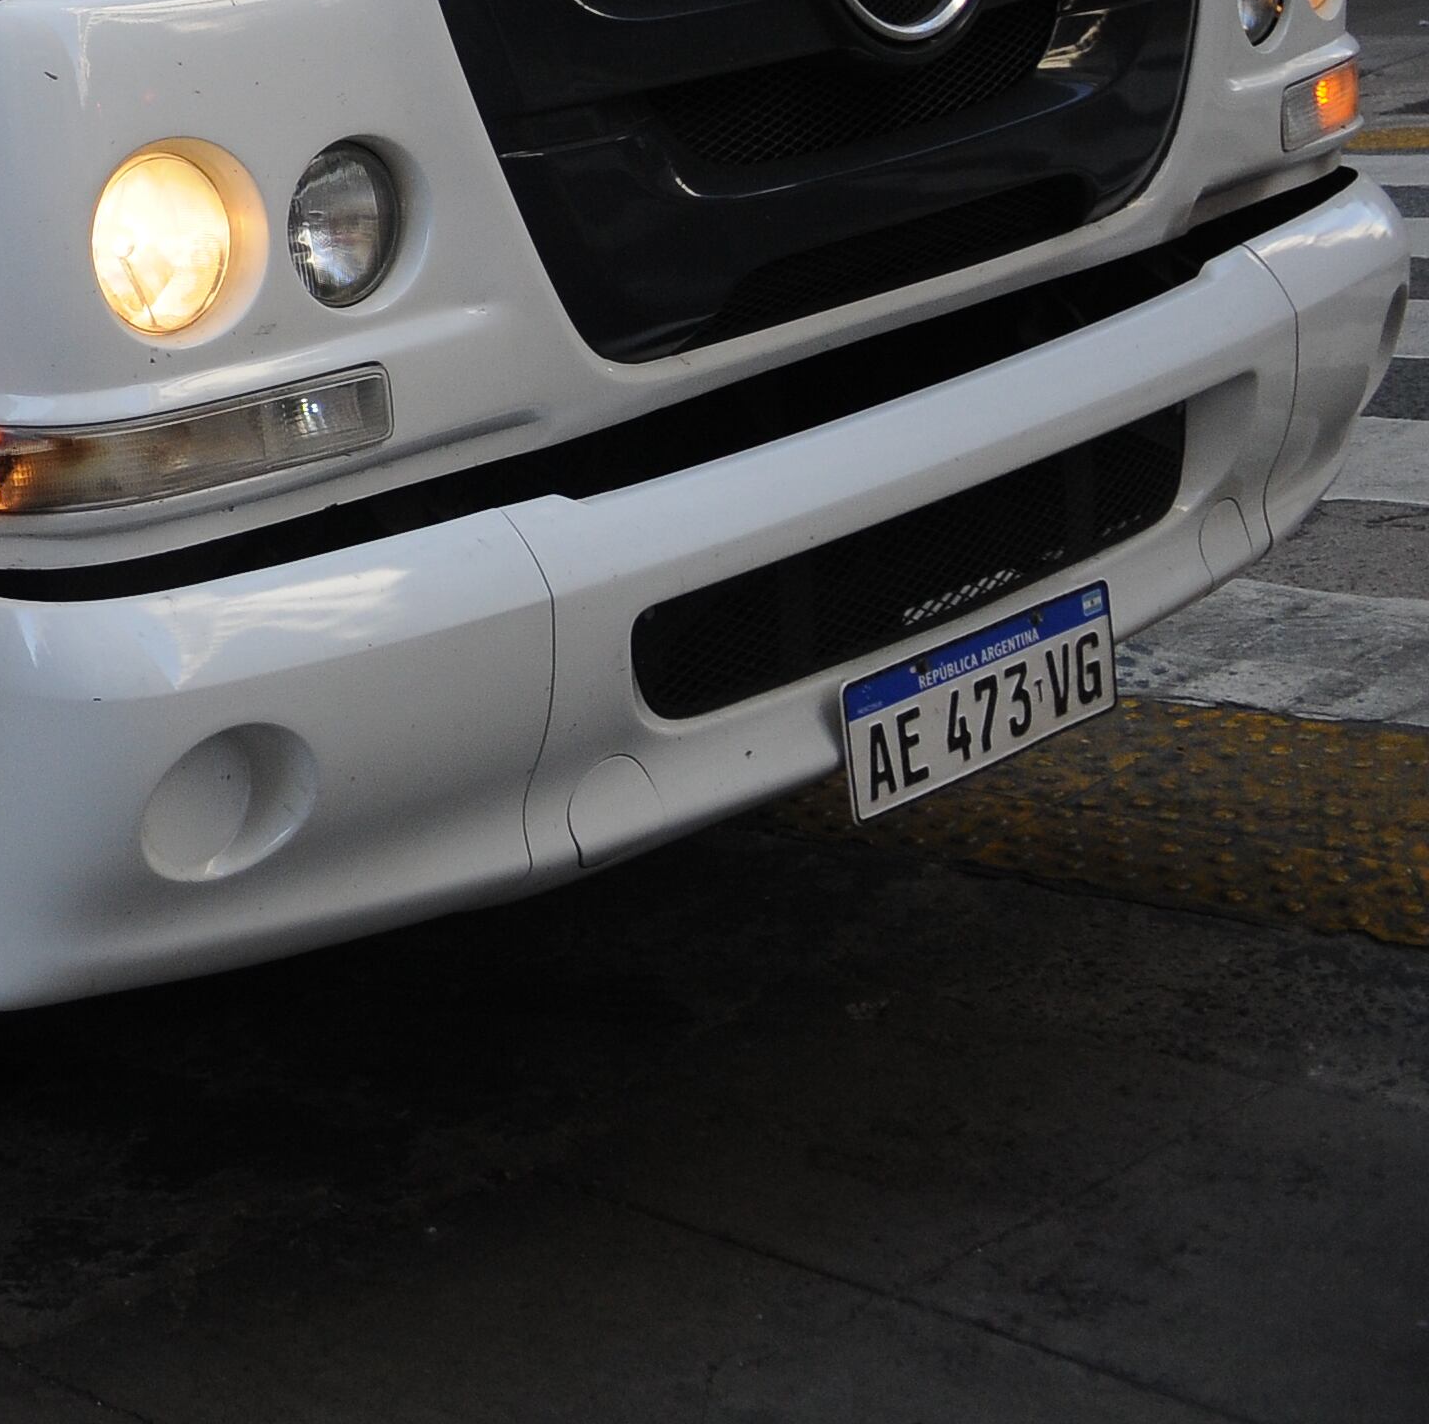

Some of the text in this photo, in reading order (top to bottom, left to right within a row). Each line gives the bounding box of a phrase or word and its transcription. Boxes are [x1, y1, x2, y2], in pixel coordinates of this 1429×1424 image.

[918, 627, 1040, 689] REPÚBLICA ARGENTINA
[869, 706, 929, 802] AE
[947, 661, 1032, 762] 473
[1045, 632, 1103, 718] VG
